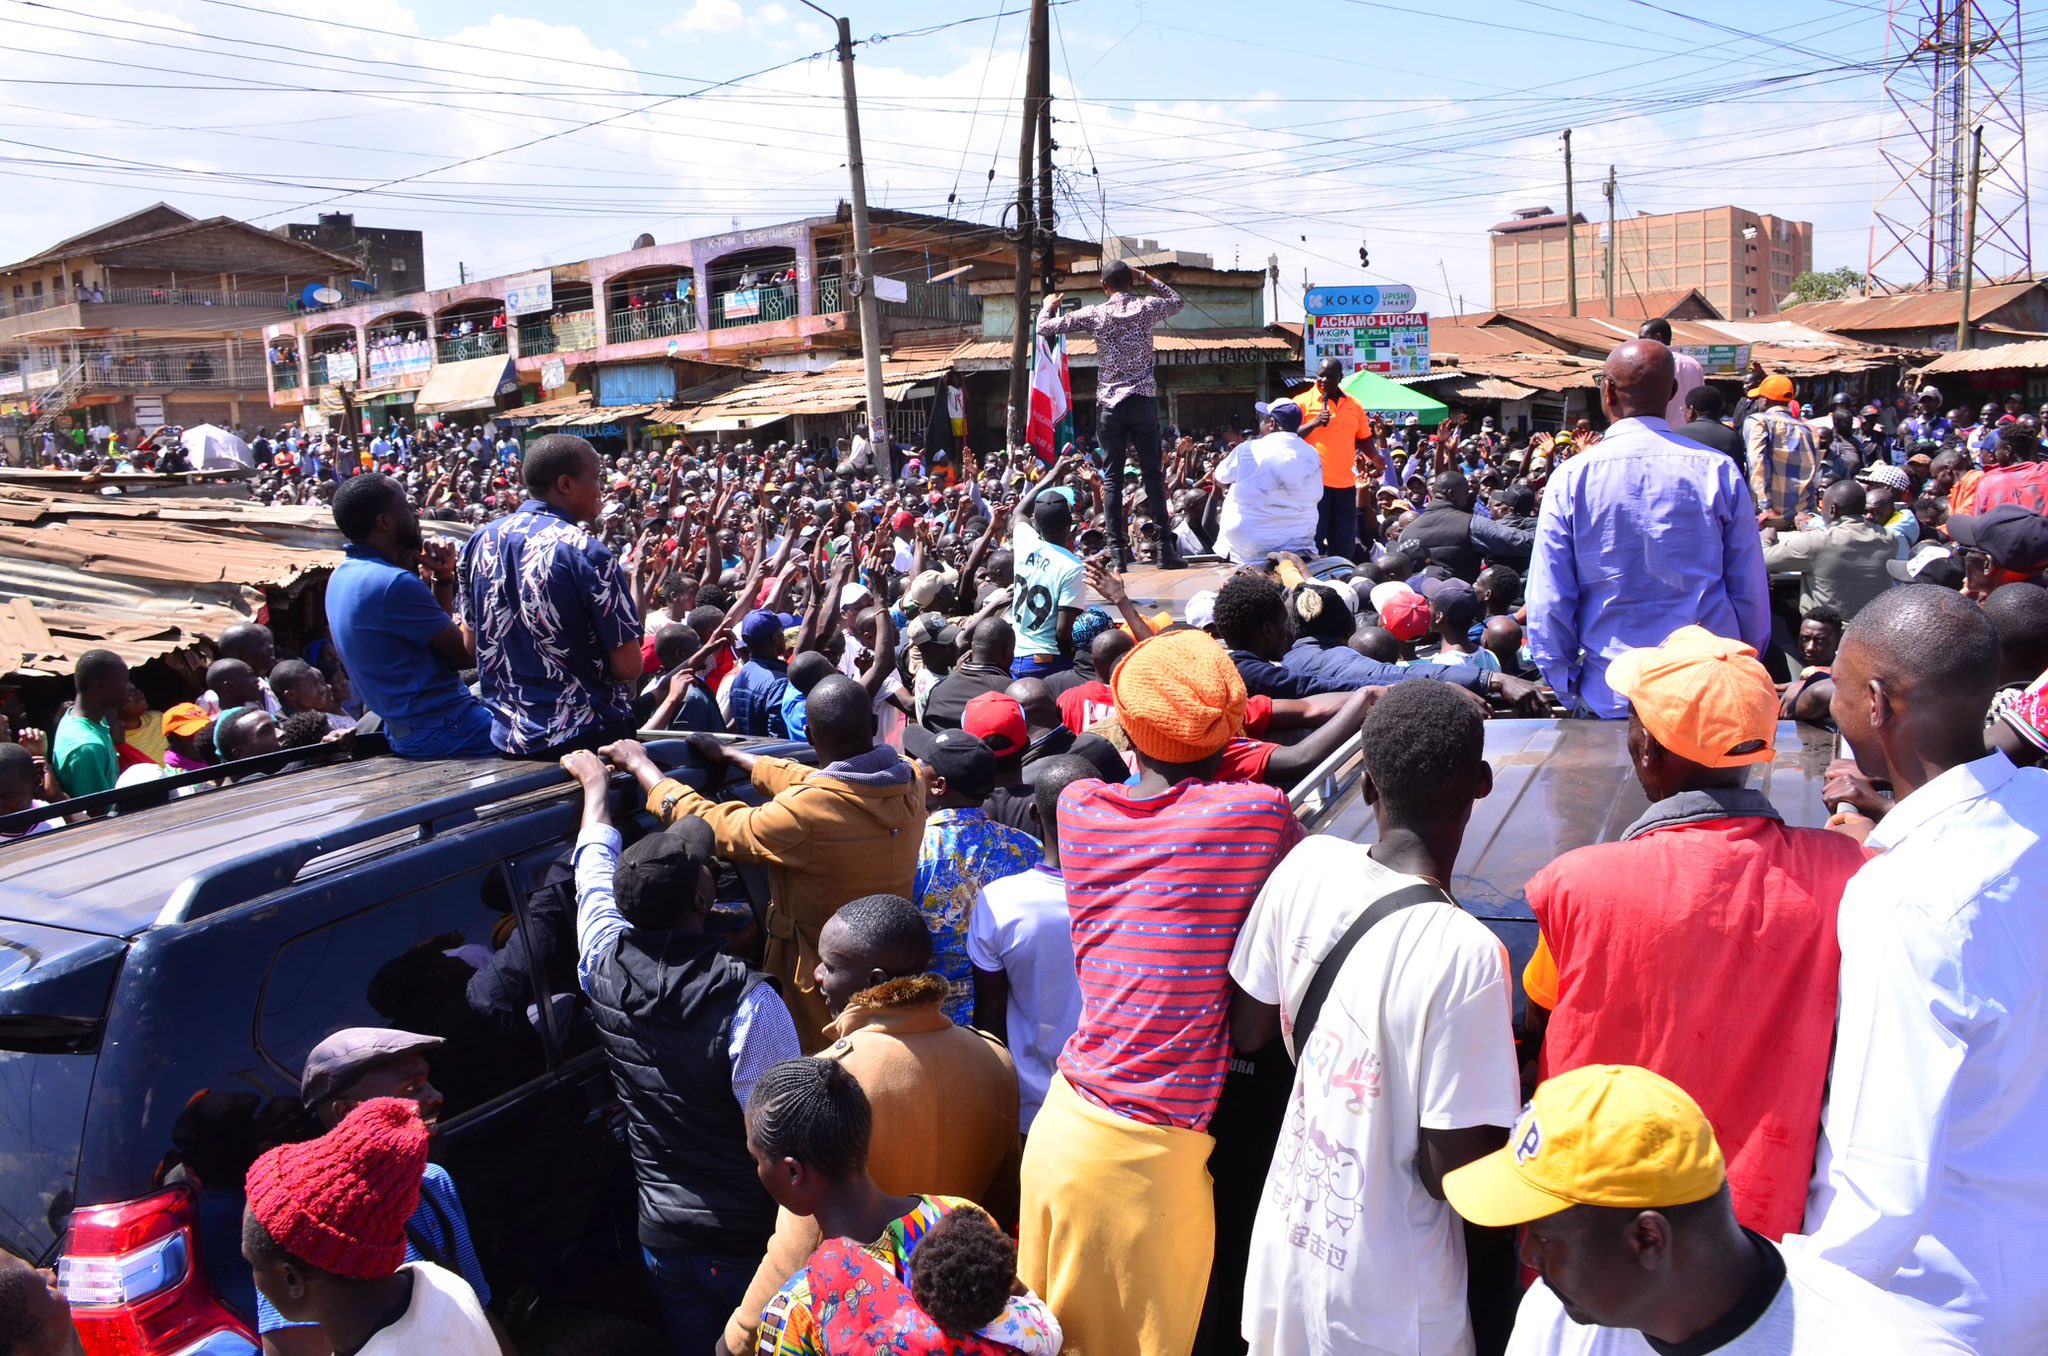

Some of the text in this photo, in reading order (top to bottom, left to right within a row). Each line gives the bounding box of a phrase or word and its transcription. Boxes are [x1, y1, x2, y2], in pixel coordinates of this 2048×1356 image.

[1326, 294, 1374, 306] KOKO
[1320, 314, 1423, 327] ACHAMO LUCHA
[1208, 348, 1281, 363] CHARGING
